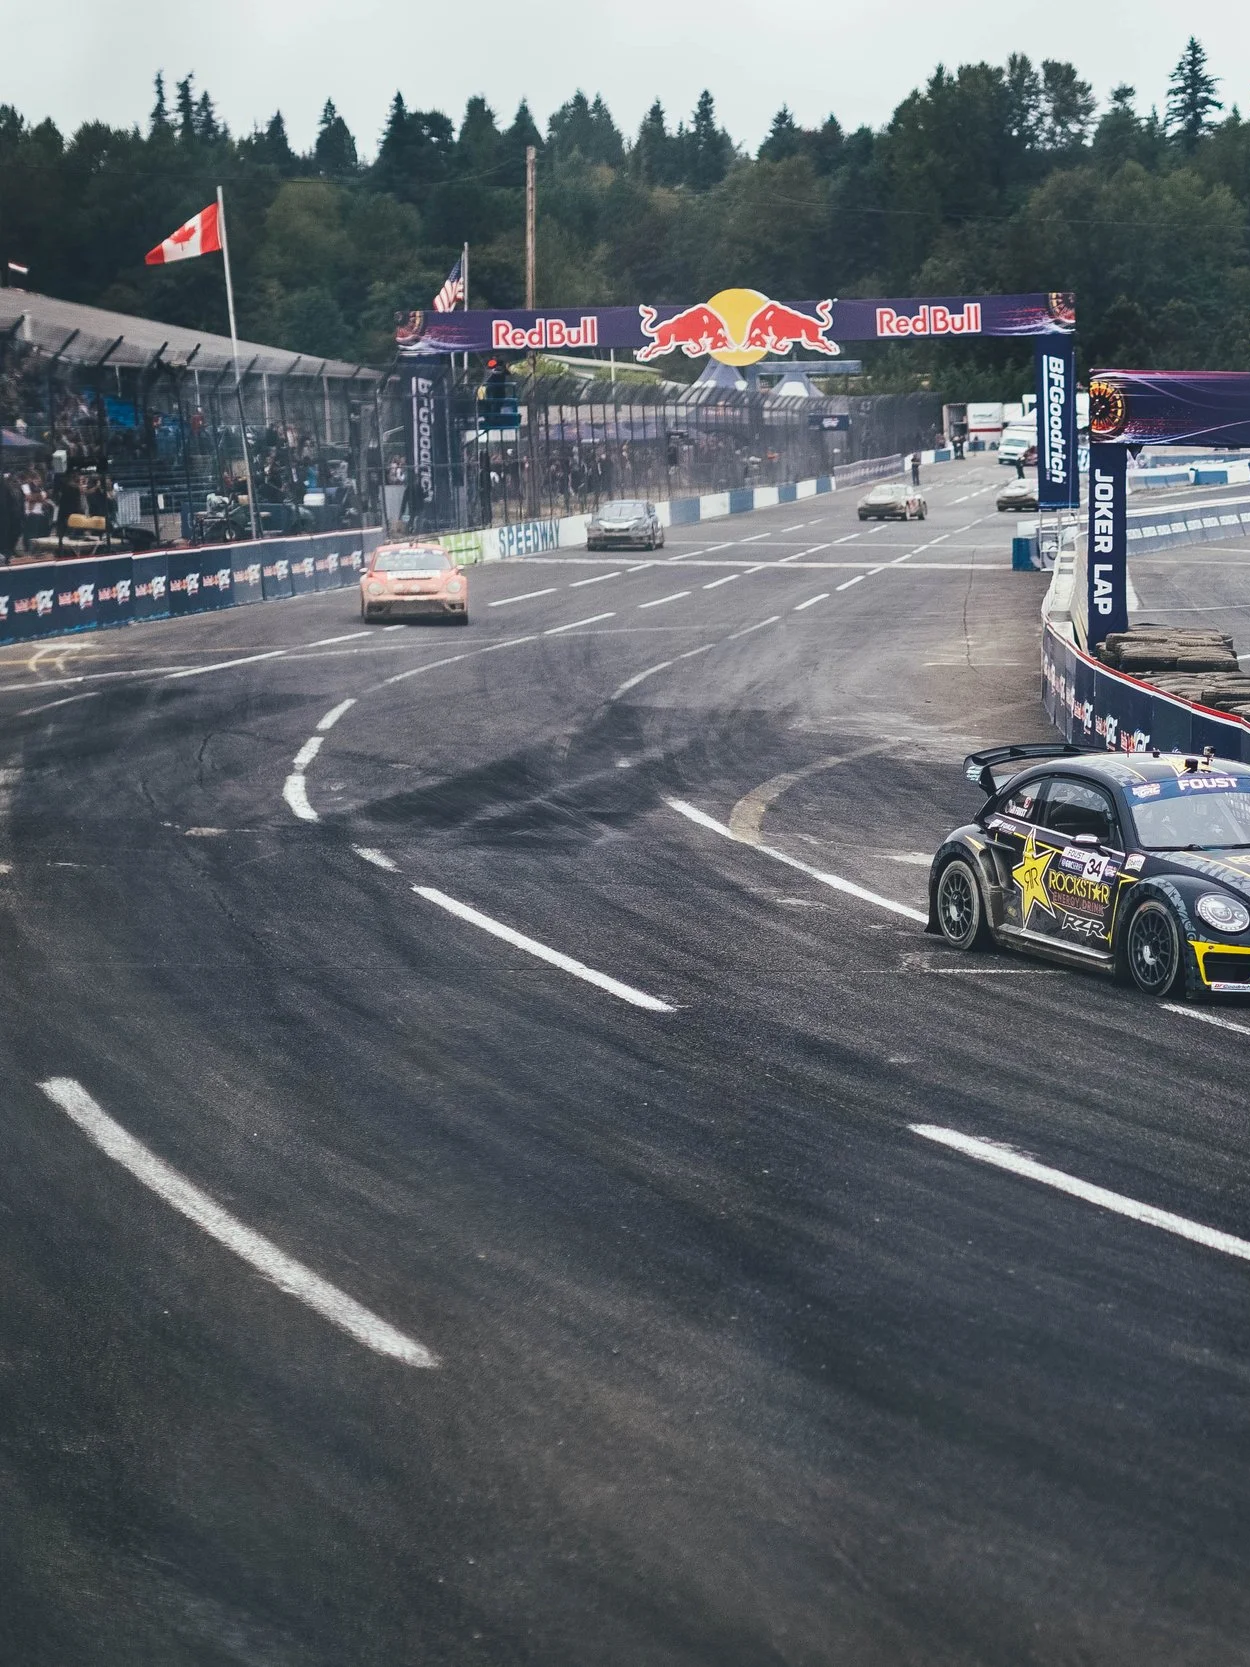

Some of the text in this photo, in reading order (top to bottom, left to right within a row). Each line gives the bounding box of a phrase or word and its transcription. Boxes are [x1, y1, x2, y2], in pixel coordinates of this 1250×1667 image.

[1049, 356, 1067, 484] BFGoodrich
[498, 519, 560, 559] SPEEDWAY
[1094, 468, 1113, 615] JOKER LAP
[1178, 778, 1237, 790] FOUST
[1067, 849, 1085, 860] FOUST
[1087, 858, 1104, 877] 34
